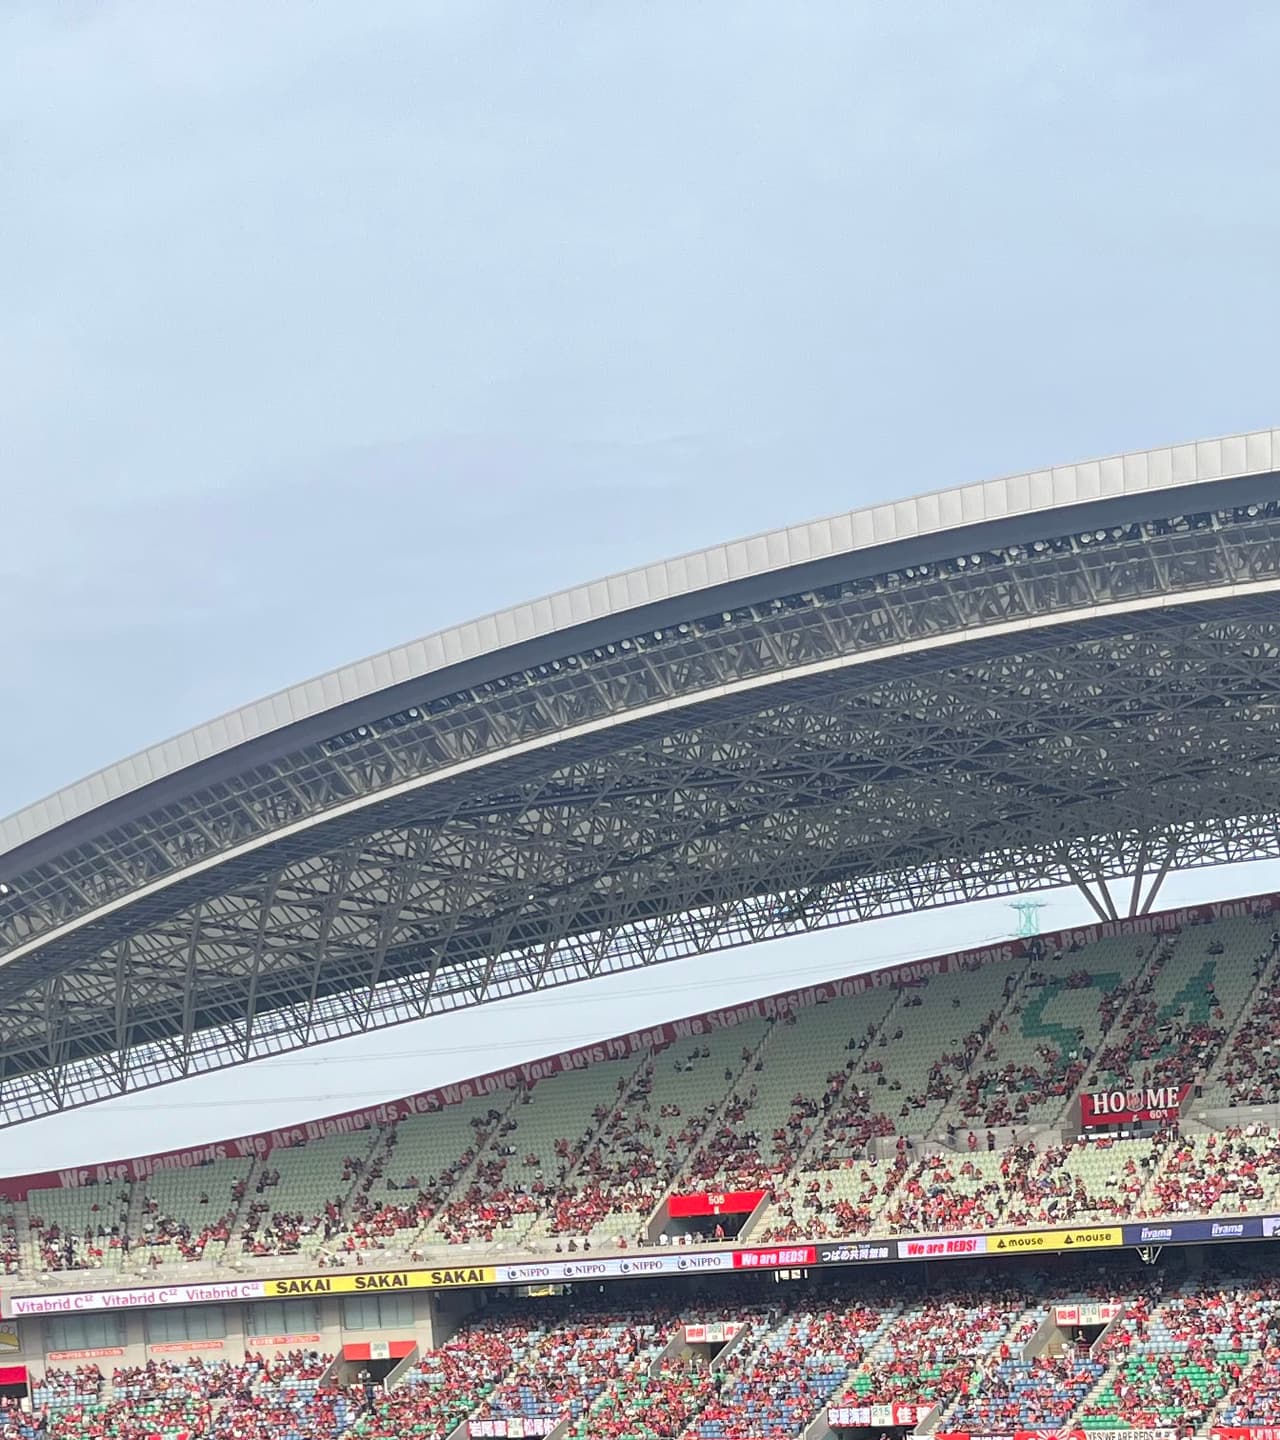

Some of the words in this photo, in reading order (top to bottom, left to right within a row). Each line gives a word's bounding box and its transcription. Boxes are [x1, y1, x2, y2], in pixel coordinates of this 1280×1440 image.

[1061, 925, 1098, 949] Red
[1101, 907, 1199, 941] Diamonds
[673, 1018, 705, 1040] We
[706, 1000, 763, 1029] Stand
[833, 971, 867, 996] You
[872, 953, 947, 984] Forever
[404, 1091, 438, 1115] Yes
[440, 1083, 472, 1107] We
[474, 1071, 516, 1099] Love
[559, 1046, 605, 1074] Boys
[629, 1029, 665, 1054] Red
[59, 1168, 89, 1188] We
[96, 1162, 127, 1181] Are
[132, 1141, 226, 1177] Diamonds
[235, 1133, 267, 1157] We
[273, 1127, 302, 1149] Are
[306, 1103, 398, 1141] Diamonds
[1076, 1233, 1111, 1244] mouse
[1141, 1227, 1171, 1241] iiyama
[907, 1243, 924, 1256] We
[926, 1243, 944, 1254] are
[947, 1239, 977, 1253] REDS!
[1009, 1237, 1044, 1248] mouse
[631, 1260, 663, 1271] NIPPO
[690, 1256, 720, 1268] NIPPO
[741, 1252, 758, 1266] We
[760, 1253, 777, 1265] are
[779, 1250, 807, 1264] REDS!
[431, 1269, 484, 1285] SAKAI
[520, 1267, 549, 1278] NIPPO
[576, 1264, 606, 1275] NIPPO
[276, 1279, 331, 1294] SAKAI
[355, 1274, 408, 1289] SAKAI
[101, 1292, 155, 1307] Vitabrid
[186, 1286, 239, 1300] Vitabrid
[16, 1298, 70, 1313] Vitabrid
[872, 1406, 890, 1416] 215
